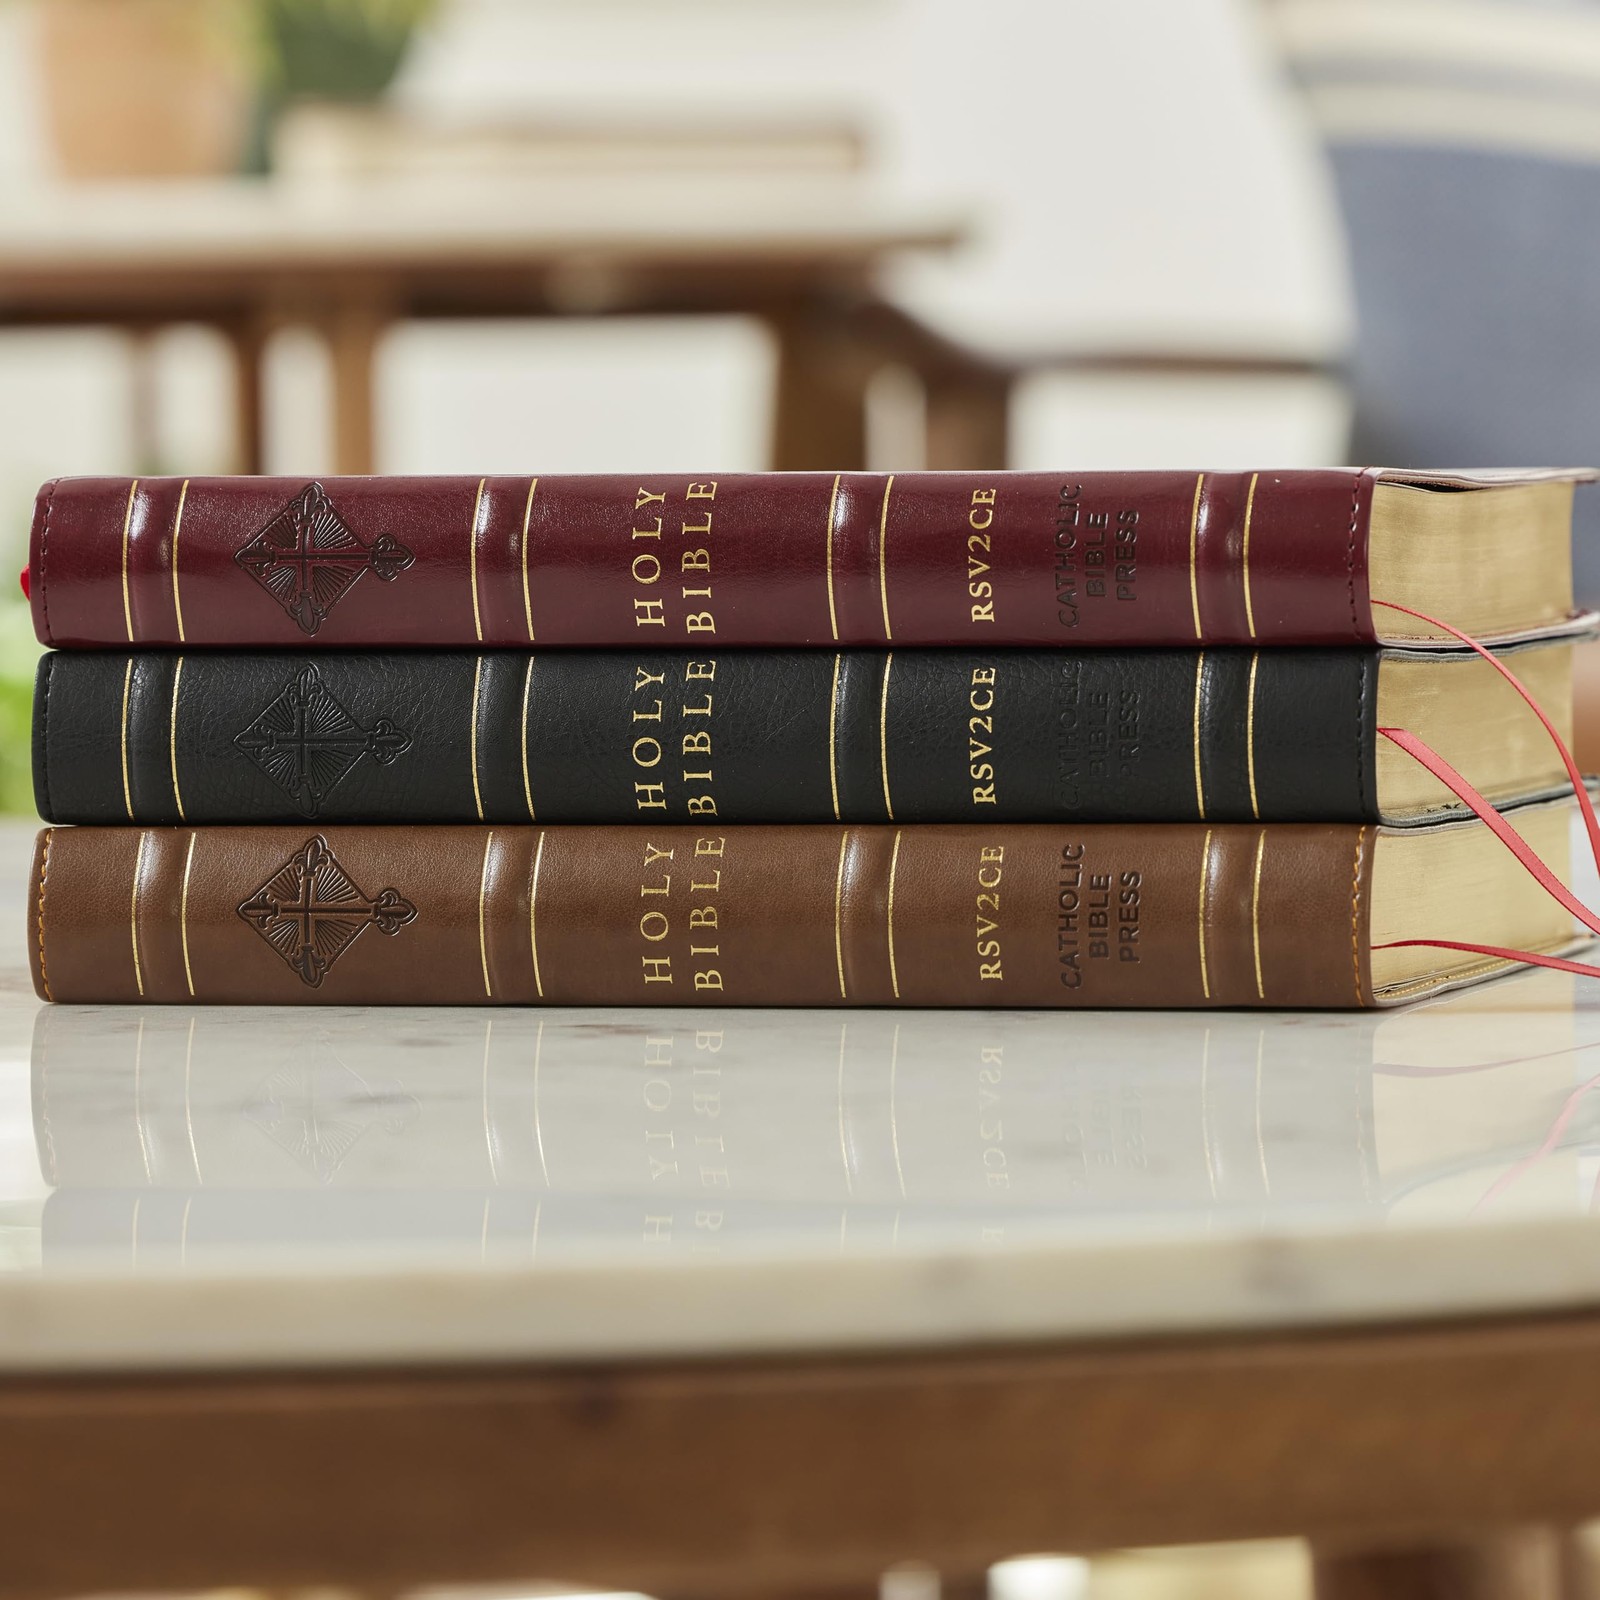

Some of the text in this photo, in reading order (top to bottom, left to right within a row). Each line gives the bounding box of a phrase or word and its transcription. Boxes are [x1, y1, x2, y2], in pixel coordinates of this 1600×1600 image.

[632, 487, 666, 626] HOLY
[682, 481, 718, 634] BIBLE
[968, 488, 996, 622] RSV2CE
[1055, 484, 1082, 628] CATHOLIC
[1084, 512, 1109, 598] BIBLE
[1115, 510, 1139, 601] PRESS
[632, 666, 667, 810] HOLY
[682, 660, 718, 816] BIBLE
[969, 667, 997, 805] RSV2CE
[640, 842, 674, 984] HOLY
[690, 837, 726, 991] BIBLE
[976, 846, 1004, 981] RSV2CE
[1058, 843, 1085, 989] CATHOLIC
[1088, 873, 1112, 960] BIBLE
[1118, 870, 1142, 963] PRESS
